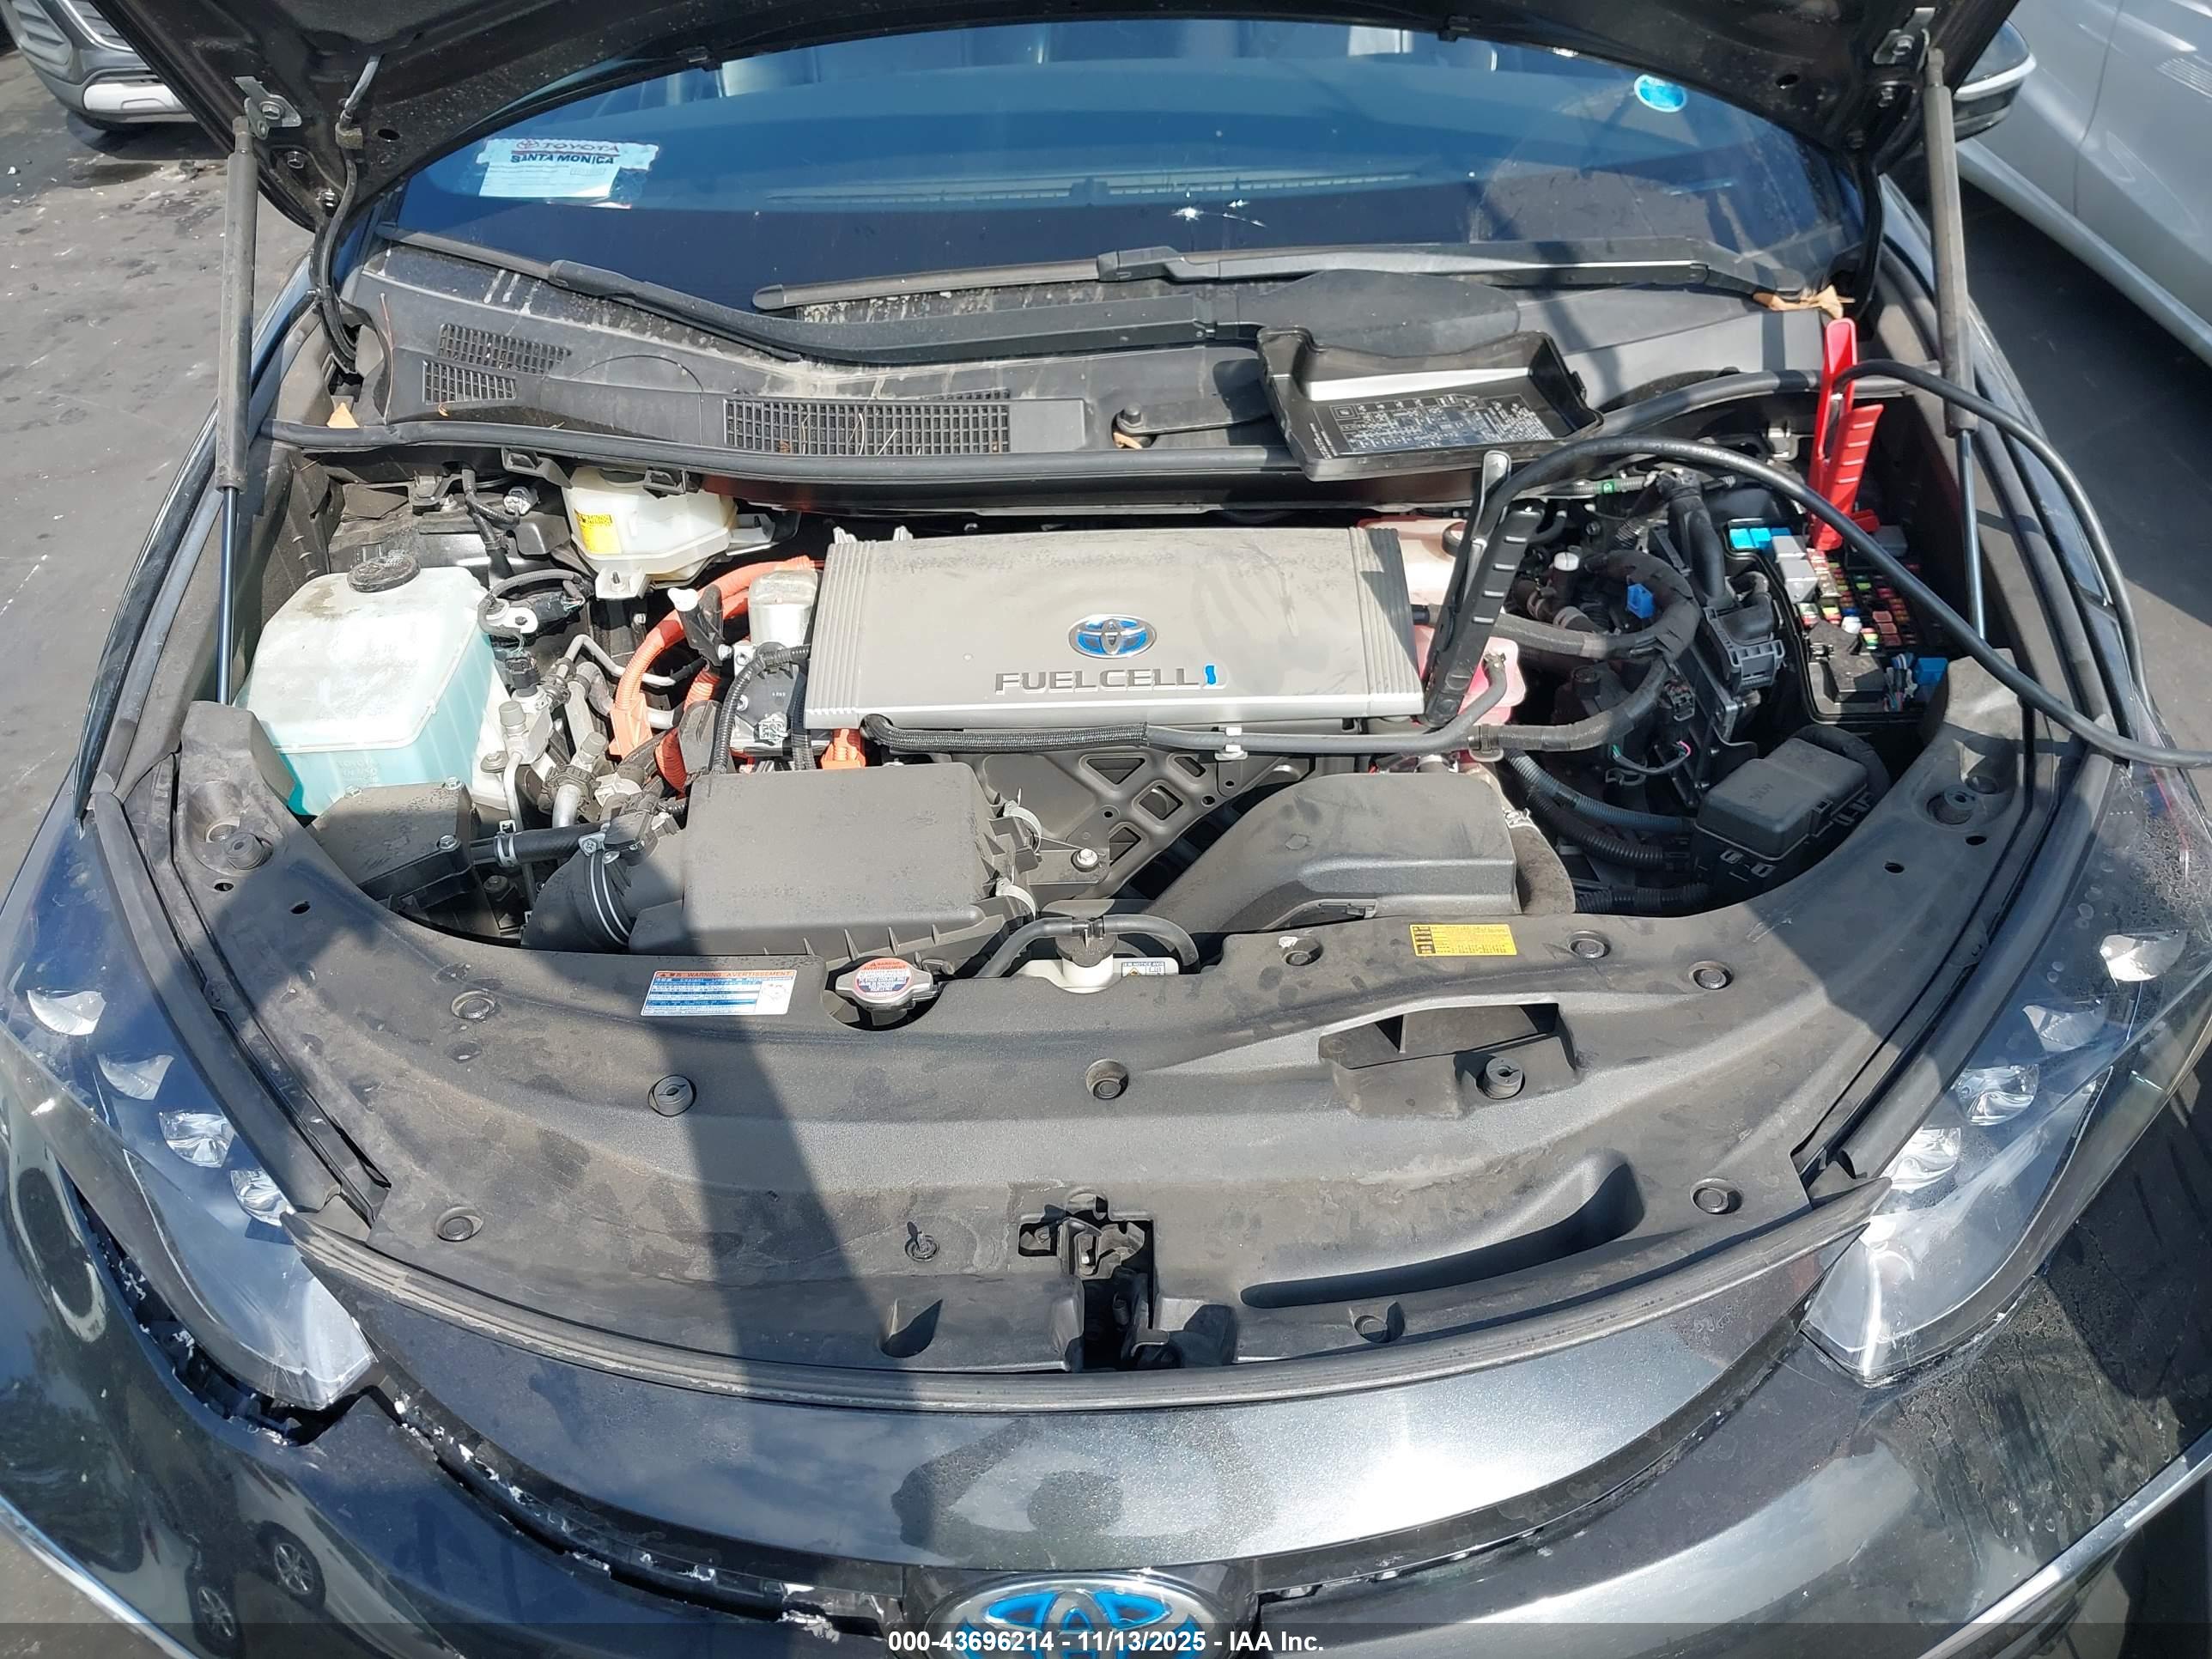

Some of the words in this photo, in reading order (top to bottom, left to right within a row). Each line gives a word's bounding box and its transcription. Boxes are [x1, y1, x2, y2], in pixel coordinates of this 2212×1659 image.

[542, 142, 620, 153] TOYOTA
[510, 153, 554, 163] SANTA
[556, 155, 615, 164] MONICA
